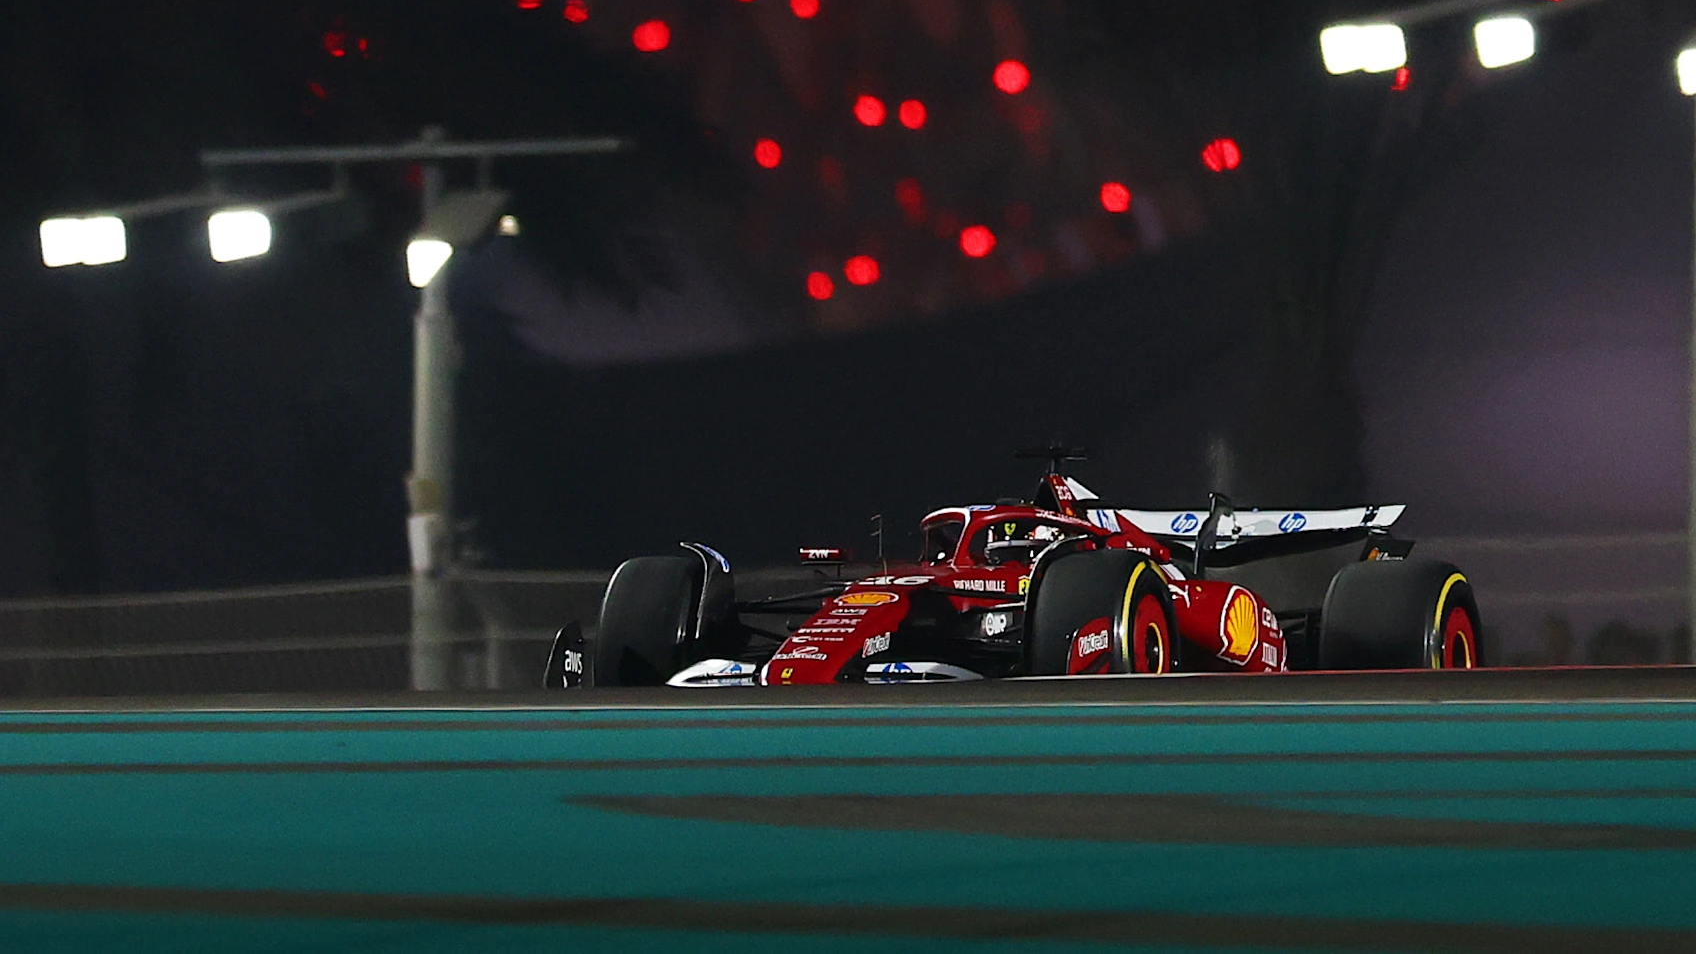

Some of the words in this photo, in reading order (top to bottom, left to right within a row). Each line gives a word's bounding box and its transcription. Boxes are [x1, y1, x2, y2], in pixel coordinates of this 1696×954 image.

[1172, 513, 1198, 533] hp
[1279, 513, 1306, 533] hp
[564, 649, 583, 675] aws
